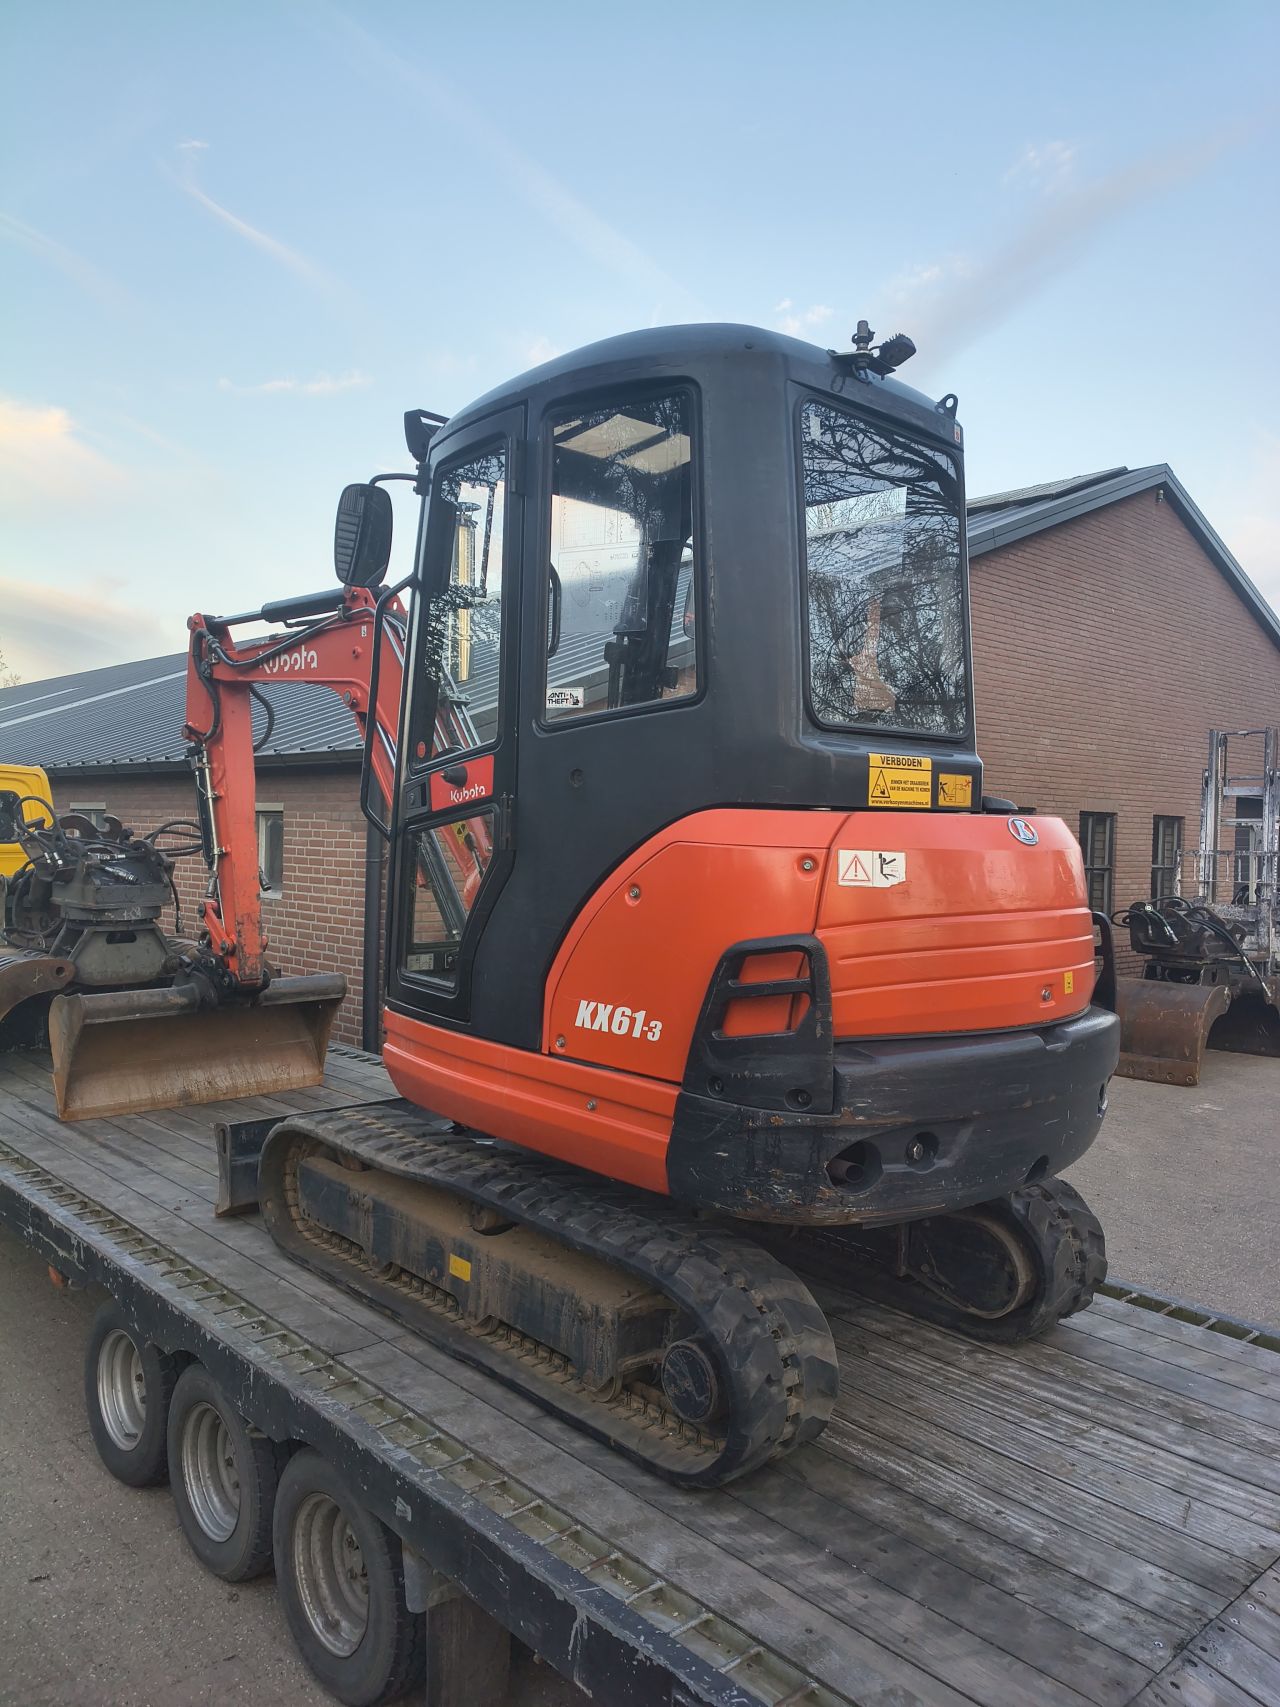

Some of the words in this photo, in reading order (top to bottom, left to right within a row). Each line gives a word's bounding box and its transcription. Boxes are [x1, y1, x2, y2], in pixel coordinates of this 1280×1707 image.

[880, 755, 922, 767] VERBODEN
[450, 783, 486, 803] Kubota
[575, 1000, 663, 1042] KX61-3
